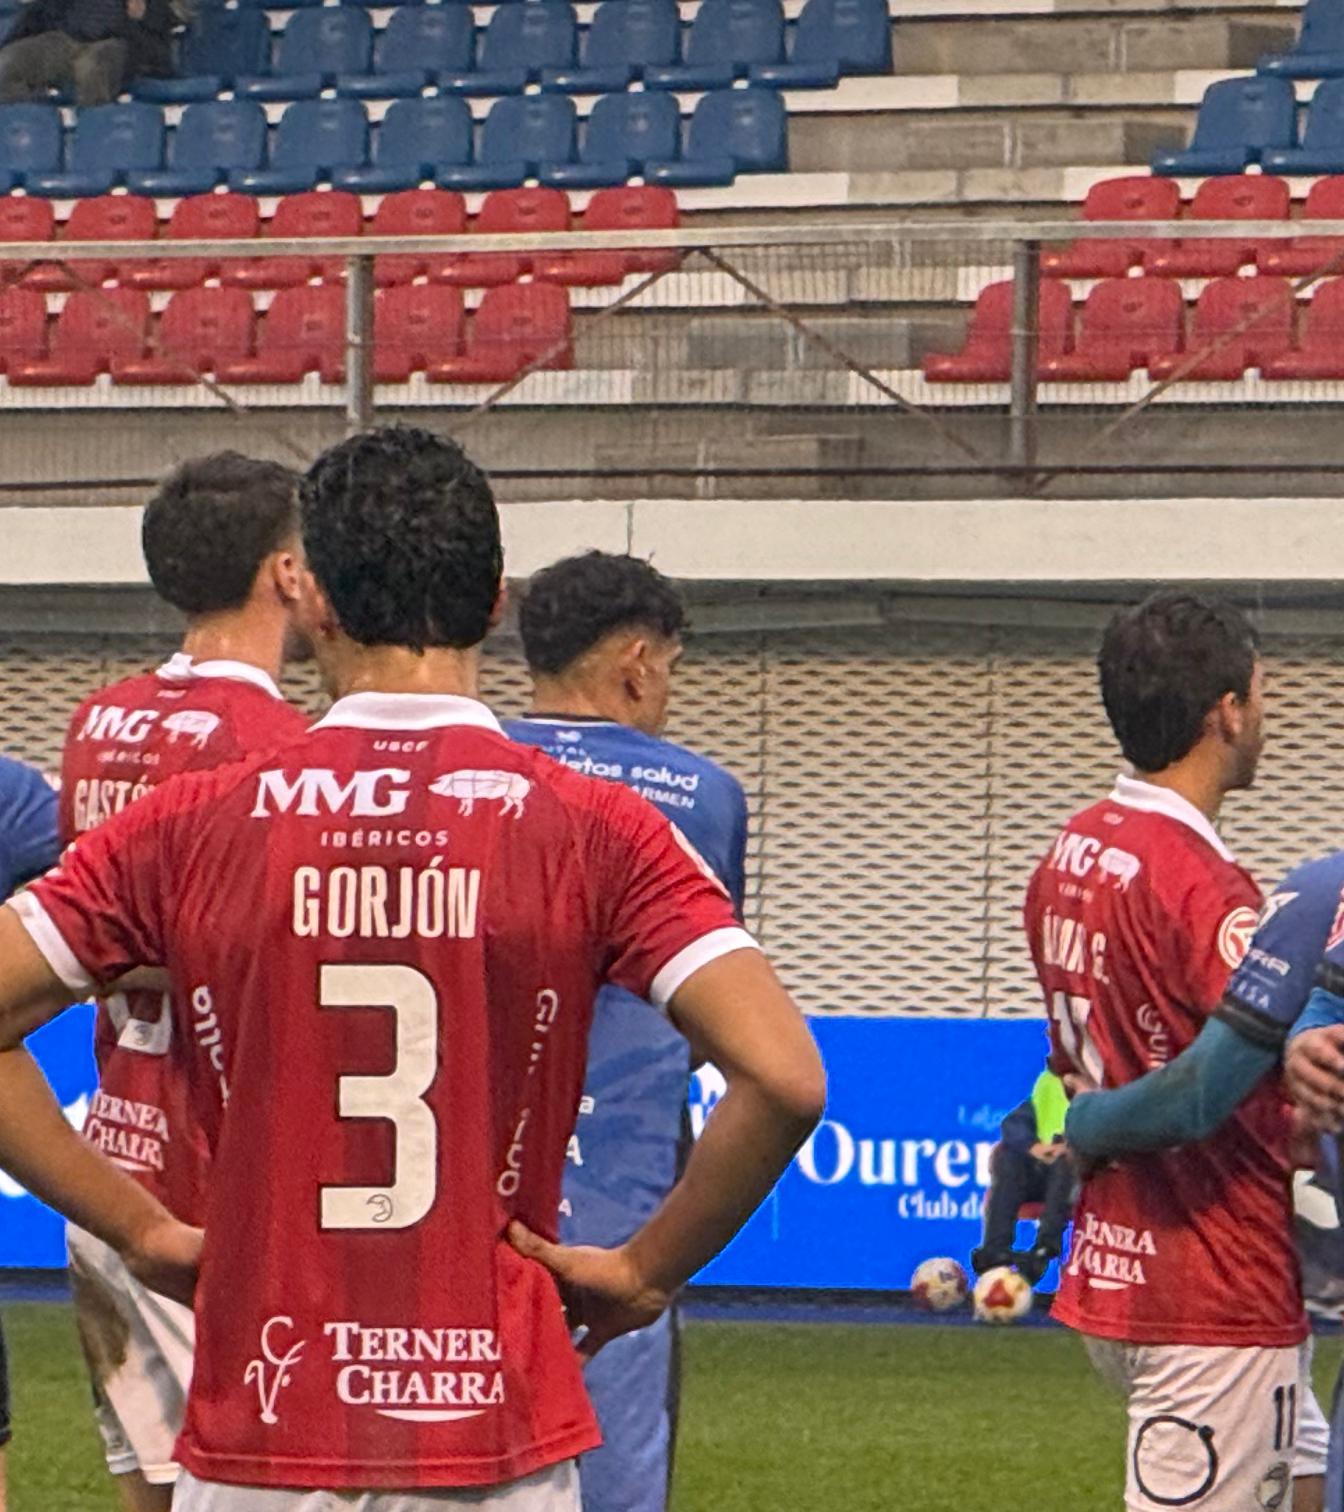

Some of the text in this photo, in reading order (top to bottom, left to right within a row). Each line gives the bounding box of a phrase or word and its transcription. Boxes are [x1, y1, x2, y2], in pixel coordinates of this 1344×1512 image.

[74, 774, 157, 832] GASTÓ
[250, 768, 411, 818] MMG
[630, 765, 699, 792] salud
[320, 828, 449, 848] IBÉRICOS
[293, 855, 481, 939] GORJÓN
[320, 963, 439, 1231] 3
[898, 1190, 959, 1219] Club
[336, 1363, 506, 1406] CHARRA
[1273, 1383, 1297, 1451] 11
